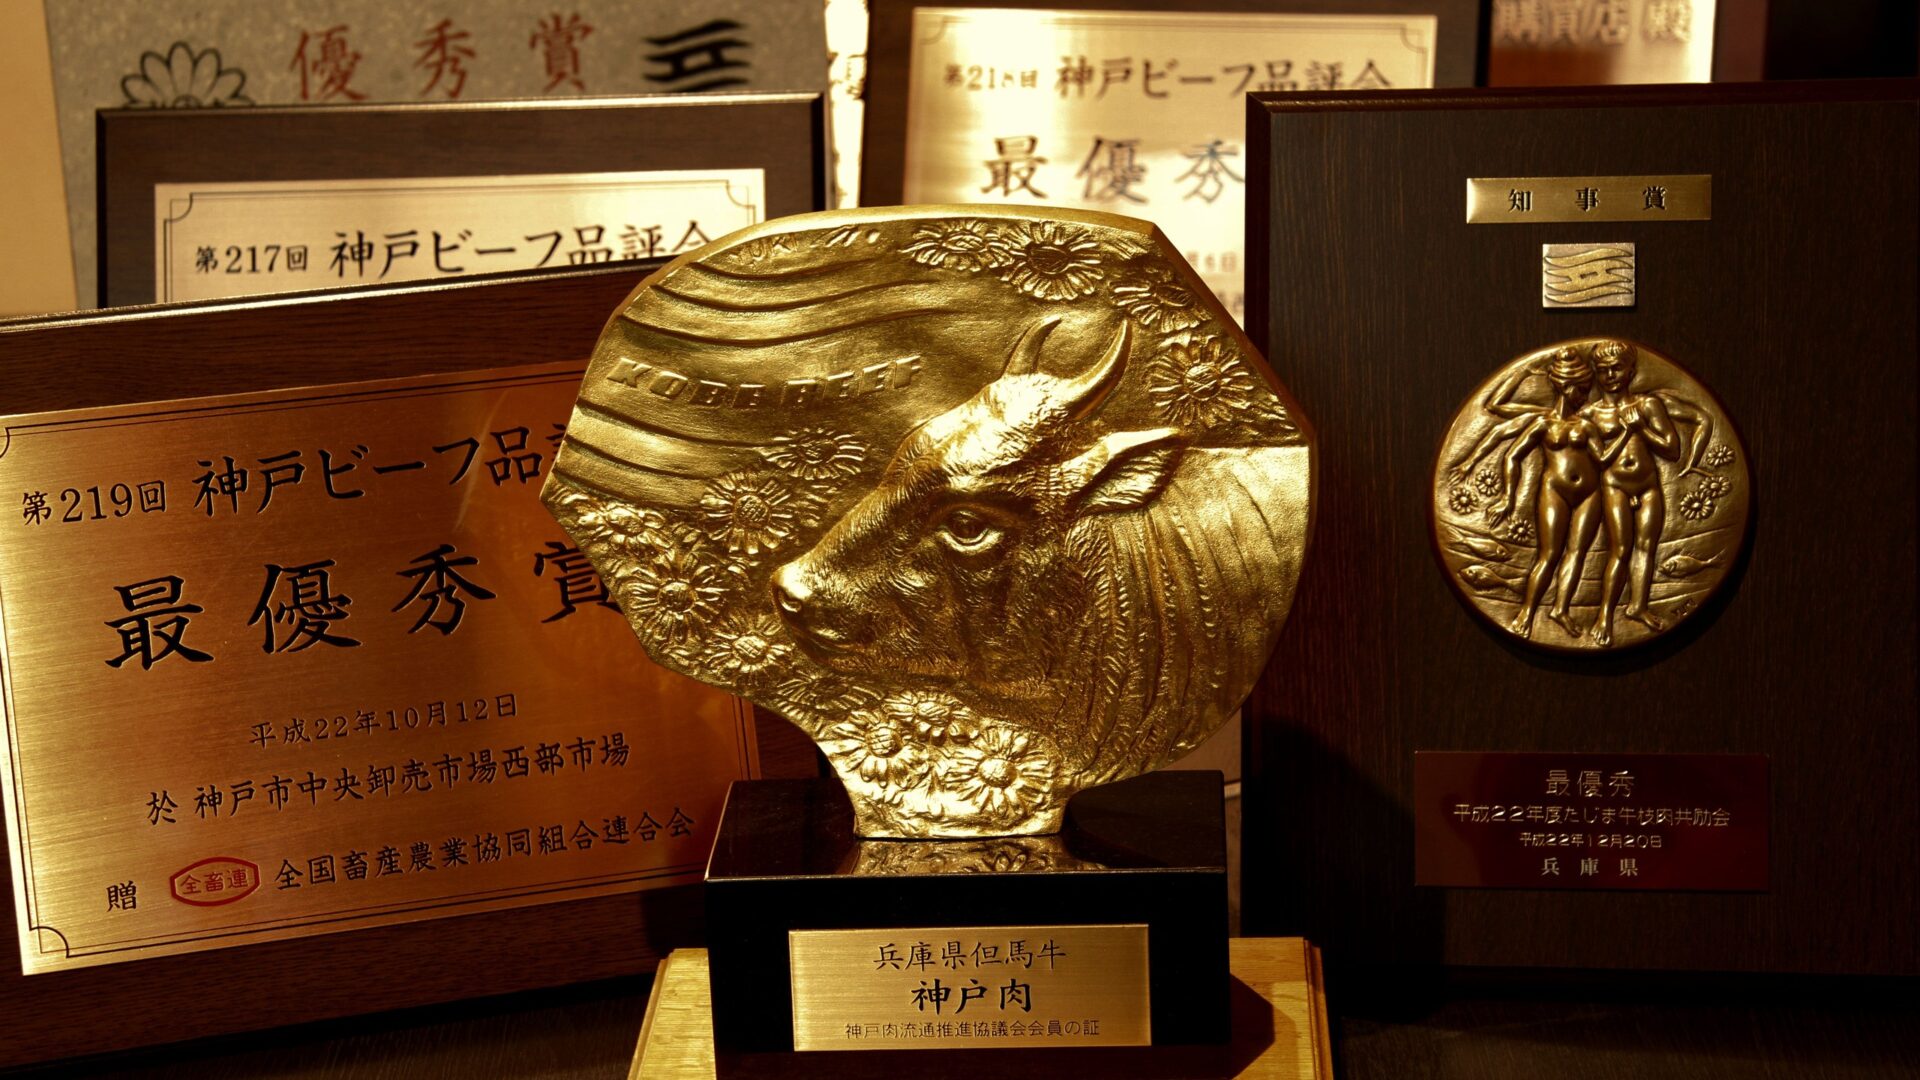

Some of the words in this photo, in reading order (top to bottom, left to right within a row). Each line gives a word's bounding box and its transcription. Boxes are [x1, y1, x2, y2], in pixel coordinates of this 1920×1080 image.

[290, 14, 596, 100] 優秀賞
[1507, 185, 1668, 214] 知事賞
[195, 243, 310, 275] 第217回
[606, 356, 764, 406] KOBE
[780, 354, 922, 404] BEEF
[21, 478, 166, 527] 第219回
[248, 694, 518, 749] 平成22年10月12日
[194, 731, 632, 821] 神戸市中央卸売市場西部市場
[1546, 769, 1636, 798] 最優秀
[105, 879, 138, 914] 贈
[178, 866, 250, 896] 全畜連
[274, 806, 697, 892] 全国畜産農業協同組合連合会
[1540, 856, 1640, 877] 兵庫県
[873, 938, 1068, 972] 兵庫県但馬牛
[910, 978, 1034, 1015] 神戸肉
[845, 1019, 1100, 1039] 神戸肉流通推進協議会会員の証
